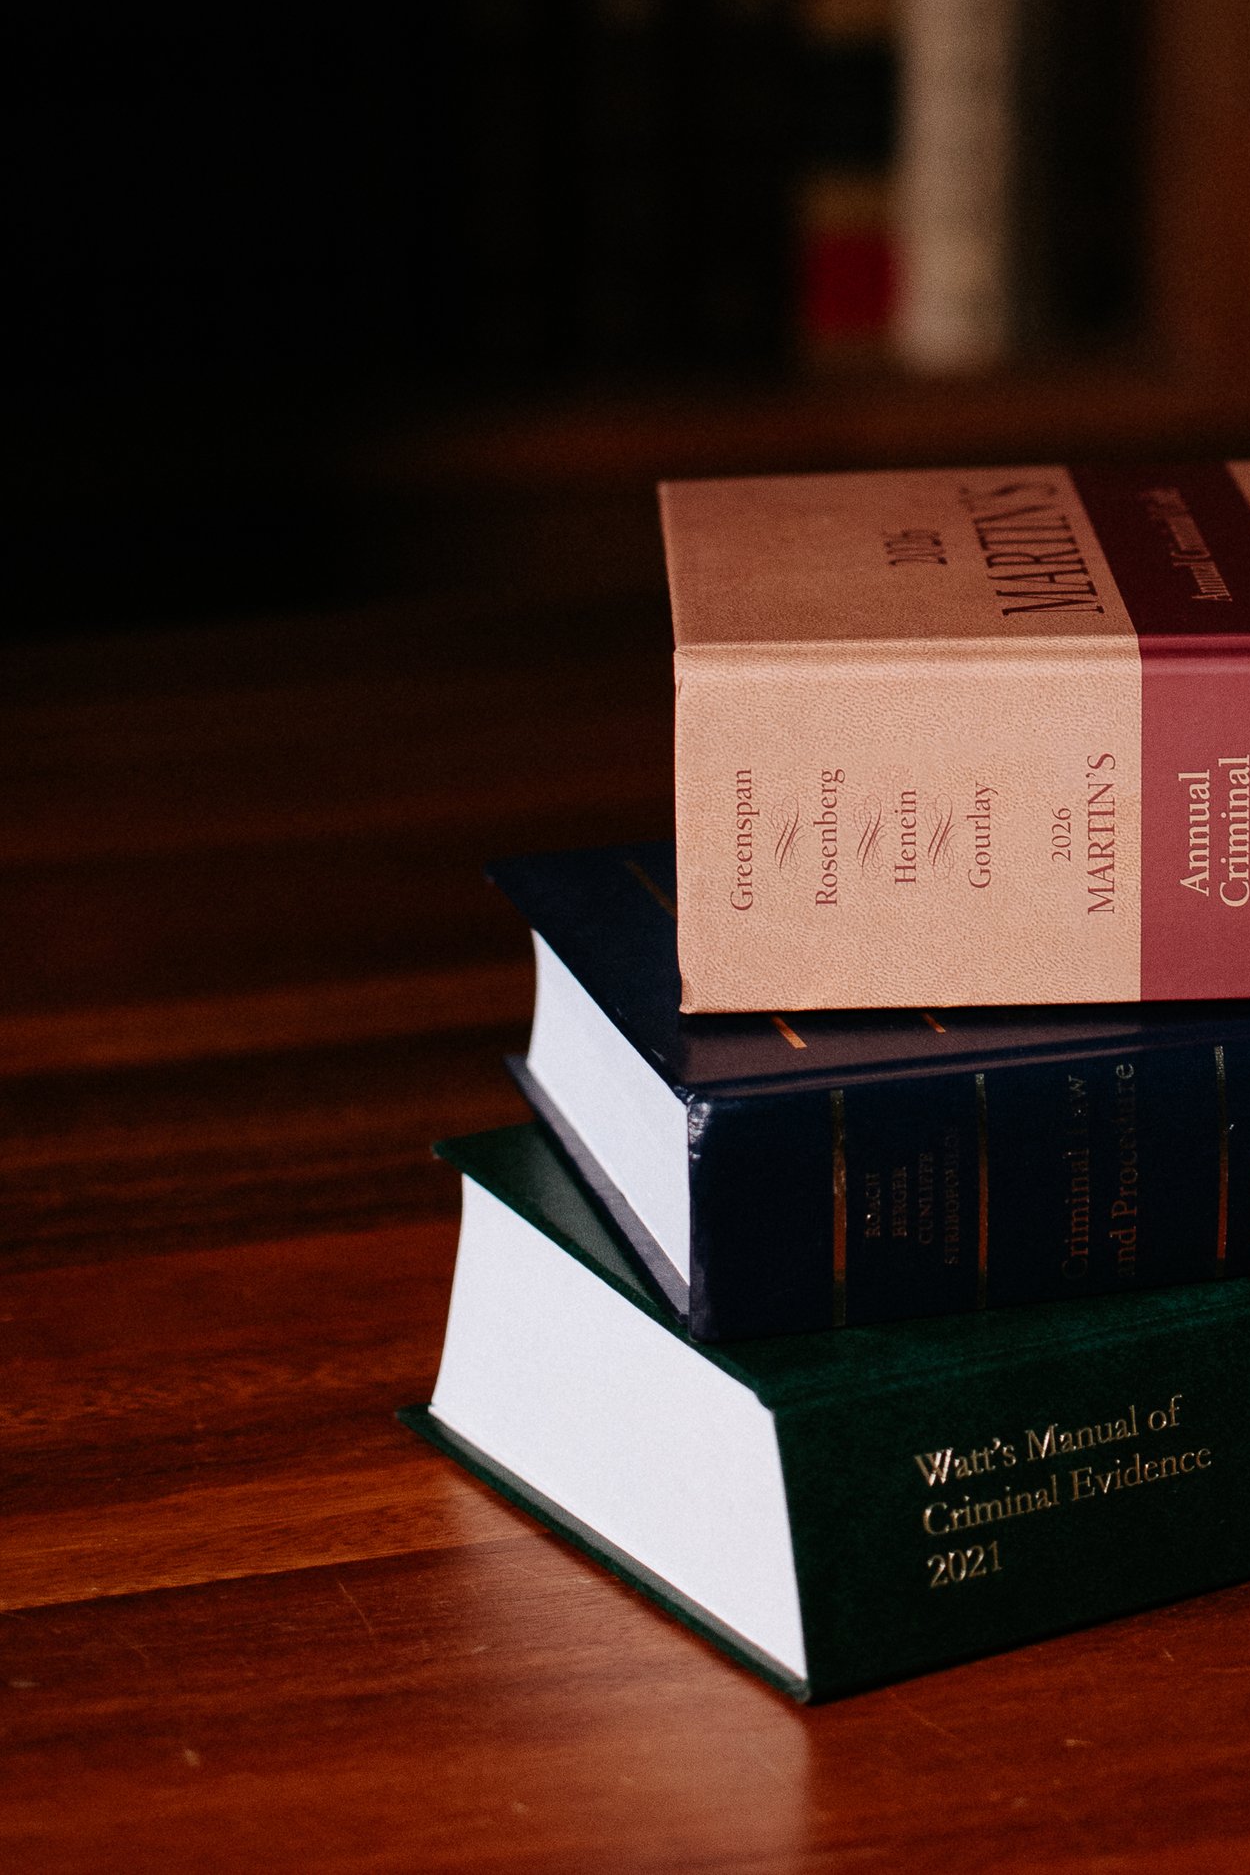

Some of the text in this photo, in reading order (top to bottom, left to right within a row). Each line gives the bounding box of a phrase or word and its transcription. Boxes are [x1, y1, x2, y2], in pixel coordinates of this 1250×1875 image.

[729, 767, 760, 912] Greenspan
[813, 768, 846, 907] Rosenberg
[894, 789, 917, 885] Henein
[966, 781, 999, 889] Gourlay
[1051, 807, 1072, 863] 2026
[1085, 753, 1116, 915] MARTIN'S
[1178, 769, 1210, 897] Annual
[1218, 754, 1250, 908] Criminal
[1061, 1148, 1090, 1278] Criminal
[1106, 1224, 1137, 1278] and
[913, 1391, 1184, 1488] Watt's Manual of
[921, 1446, 1213, 1536] Criminal Evidence
[926, 1539, 1005, 1589] 2021
